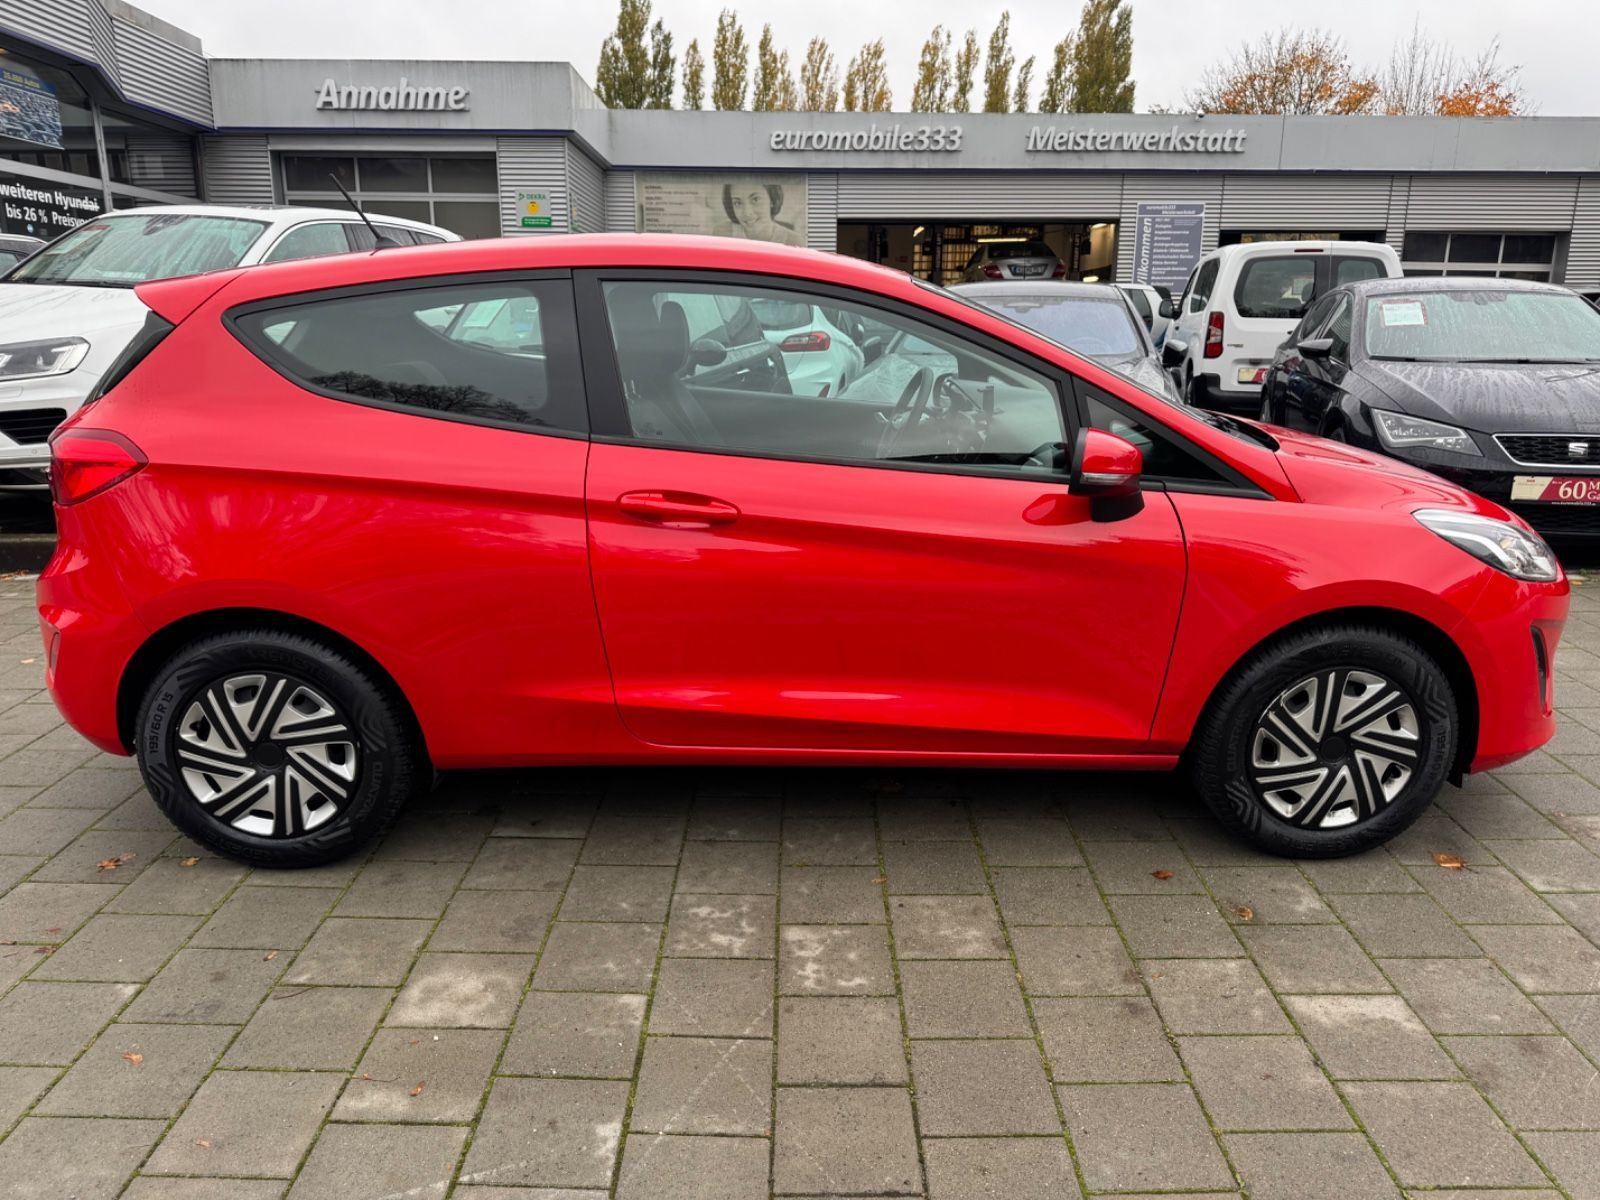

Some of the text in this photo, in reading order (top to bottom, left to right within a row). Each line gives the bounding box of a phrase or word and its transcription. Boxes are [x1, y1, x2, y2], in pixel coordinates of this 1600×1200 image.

[315, 76, 467, 111] Annahme
[769, 123, 963, 152] euromobile333
[1026, 125, 1248, 153] Meisterwerkstatt
[0, 182, 53, 204] weiteren
[5, 202, 22, 220] bis
[23, 206, 38, 222] 26
[38, 208, 48, 224] %
[1558, 480, 1587, 500] 60
